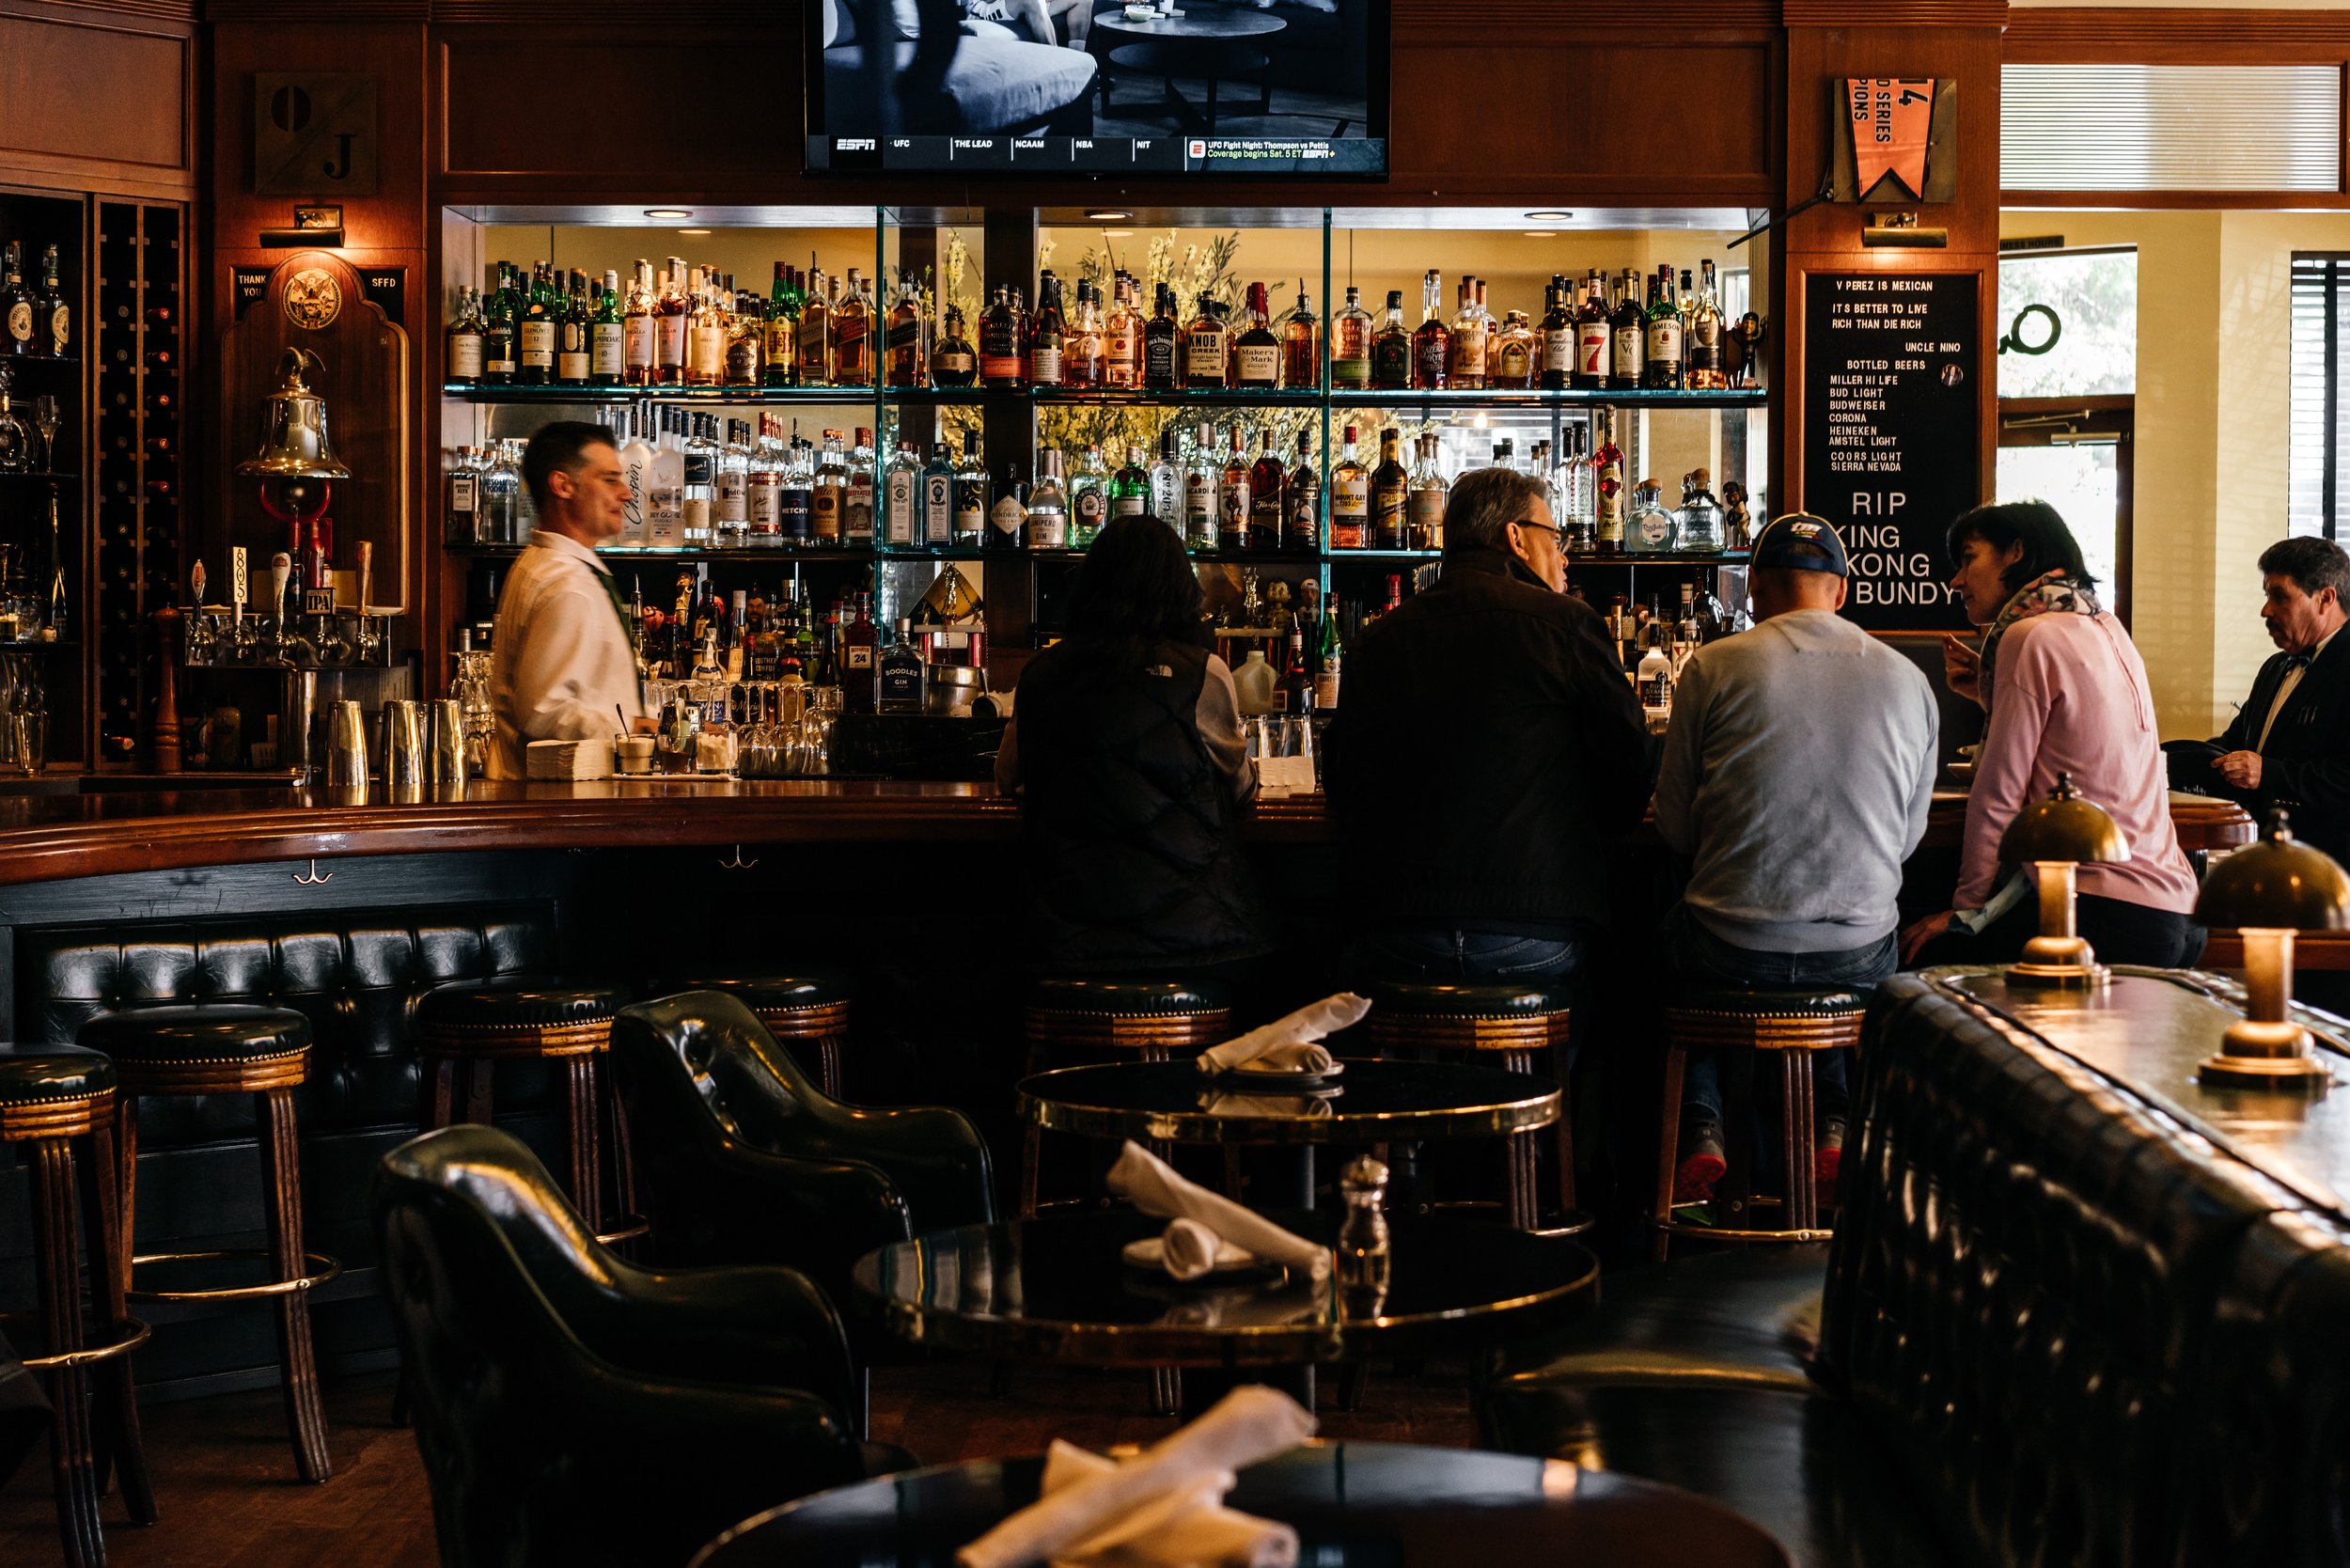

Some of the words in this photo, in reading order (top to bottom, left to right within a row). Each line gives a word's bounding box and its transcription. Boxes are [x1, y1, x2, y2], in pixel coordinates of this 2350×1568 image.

[1875, 92, 1891, 143] SERIES
[837, 138, 875, 150] ESPN
[1075, 140, 1093, 149] NBA
[1136, 140, 1152, 149] NIT
[1223, 141, 1242, 150] Fight
[1242, 141, 1263, 150] Night:
[1263, 142, 1299, 150] Thompson
[322, 133, 357, 180] J
[1207, 149, 1243, 159] Coverage
[1243, 149, 1268, 159] begins
[1269, 149, 1285, 158] Sat.
[1285, 149, 1291, 158] 5
[1292, 149, 1302, 158] ET
[238, 274, 267, 284] THANK
[371, 278, 396, 288] SFFD
[1836, 281, 1842, 290] V
[1845, 280, 1874, 290] PEREZ
[1878, 280, 1888, 290] IS
[1891, 280, 1934, 291] MEXICAN
[243, 288, 261, 297] YOU
[1854, 304, 1888, 314] BETTER
[1891, 304, 1904, 314] TO
[1907, 304, 1928, 314] LIVE
[1650, 322, 1681, 333] JAMESON
[1832, 319, 1852, 329] RICH
[1856, 319, 1880, 329] THAN
[1884, 319, 1898, 329] DIE
[1900, 319, 1921, 329] RICH
[768, 331, 793, 354] J&B
[1188, 335, 1216, 348] KNOB
[1905, 342, 1935, 353] UNCLE
[1939, 342, 1961, 353] NINO
[1582, 336, 1606, 372] 7
[1846, 359, 1888, 369] BOTTLED
[1894, 359, 1926, 369] BEERS
[1829, 374, 1863, 385] MILLER
[1865, 375, 1875, 385] HI
[1878, 375, 1898, 385] LIFE
[1829, 387, 1849, 398] BUD
[1853, 387, 1884, 398] LIGHT
[1829, 400, 1886, 411] BUDWEISER
[1828, 413, 1867, 423] CORONA
[1829, 426, 1877, 436] HEINEKEN
[1828, 435, 1865, 446] AMSTEL
[1871, 436, 1897, 447] LIGHT
[1830, 451, 1867, 461] COORS
[1871, 451, 1902, 462] LIGHT
[1831, 462, 1865, 471] SIERRA
[1867, 462, 1902, 472] NEVADA
[621, 460, 647, 525] Chopin
[814, 487, 838, 496] Tito's
[1075, 489, 1101, 509] PLYMOUTH
[1162, 490, 1173, 511] 209
[1852, 492, 1906, 515] RIP
[1847, 553, 1930, 577] KONG
[1856, 581, 1954, 604] BUNDY
[308, 595, 330, 610] IPA
[854, 654, 867, 663] 24
[885, 668, 918, 677] BOODLES
